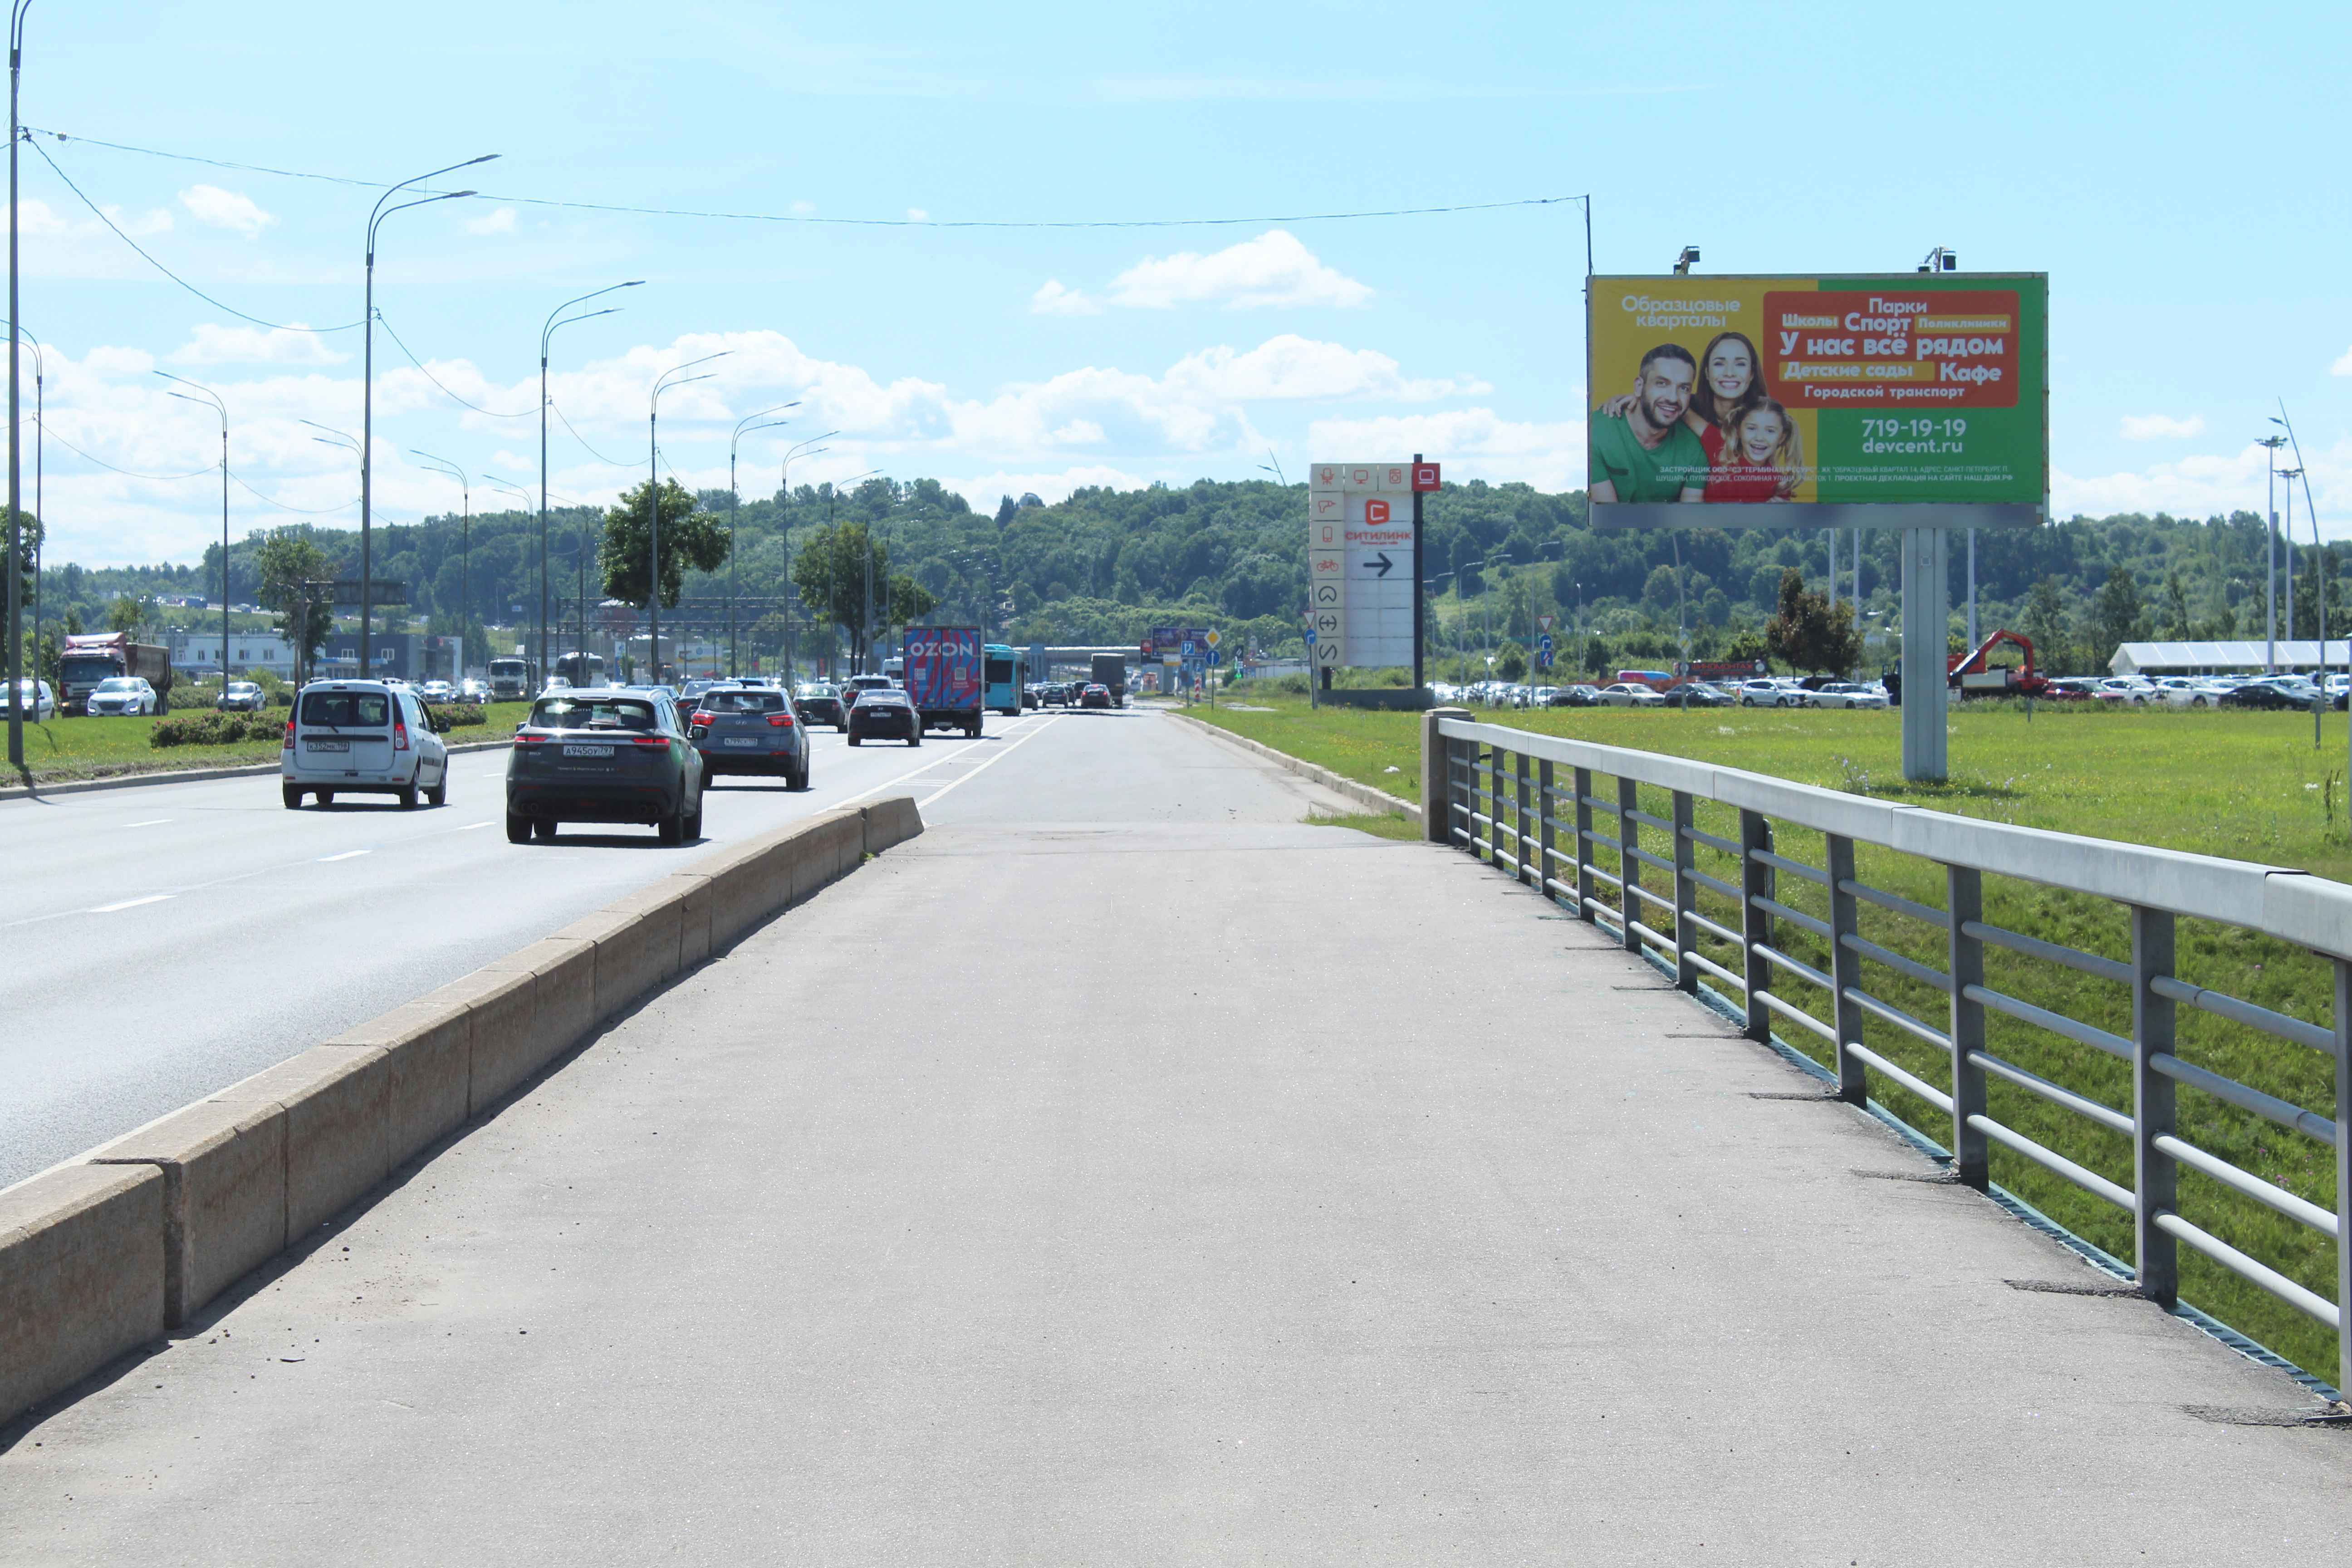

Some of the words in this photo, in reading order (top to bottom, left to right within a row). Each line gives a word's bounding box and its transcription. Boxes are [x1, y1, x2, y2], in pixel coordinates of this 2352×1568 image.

[1621, 295, 1741, 314] Образцовые
[1869, 298, 1927, 316] Парки
[1636, 314, 1727, 331] кварталы
[1782, 314, 1838, 327] Школы
[1844, 312, 1911, 335] Спорт
[1918, 317, 2007, 328] Поликлиники
[1779, 332, 1799, 355] У
[1807, 338, 1855, 355] нас
[1863, 332, 1908, 355] всё
[1916, 338, 2004, 360] рядом
[1784, 362, 1861, 380] Детские
[1866, 364, 1913, 378] сады
[1940, 363, 2002, 385] Кафе
[1805, 385, 1884, 400] Городской
[1889, 388, 1965, 400] транспорт
[1862, 419, 1967, 437] 719-19-19
[1862, 437, 1963, 453] devcent.ru
[1660, 465, 1710, 473] ЗАСТРОЙЩИК
[1878, 475, 1926, 483] ДЕКЛАРАЦИЯ
[1939, 473, 1963, 481] САЙТЕ
[1345, 531, 1413, 541] СИТИЛИНК
[910, 642, 973, 657] OZON
